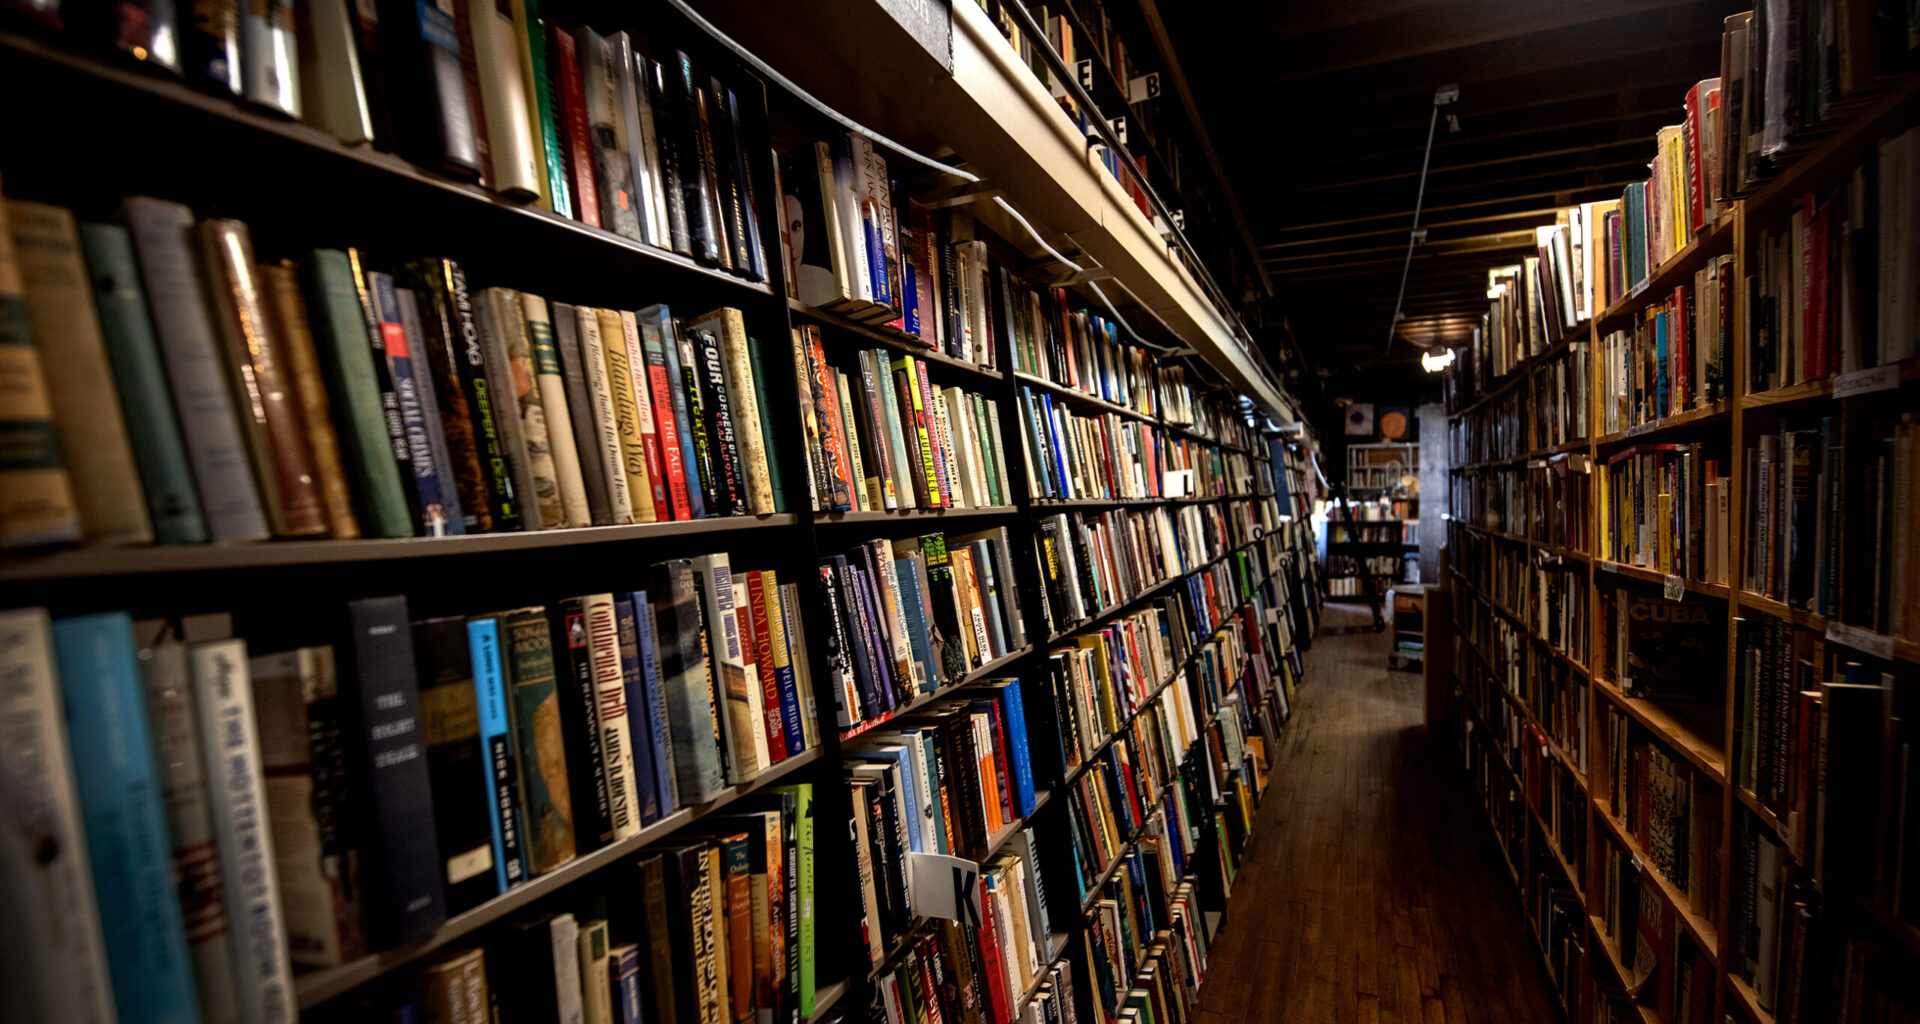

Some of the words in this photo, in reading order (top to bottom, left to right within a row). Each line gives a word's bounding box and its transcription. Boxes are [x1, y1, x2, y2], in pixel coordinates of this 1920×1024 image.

[1078, 61, 1090, 91] E
[1146, 76, 1159, 96] B
[1114, 117, 1125, 142] F
[1686, 110, 1701, 210] IMPERIAL
[874, 159, 890, 202] JOHN
[880, 202, 894, 241] JAKES
[451, 267, 471, 312] TAMI
[460, 309, 483, 367] HOAG
[623, 320, 639, 366] graphic
[588, 341, 607, 391] Blandings
[633, 367, 643, 385] the
[397, 376, 424, 426] SOCIAL
[472, 376, 497, 440] DEEPER
[598, 391, 613, 423] Builds
[635, 386, 650, 424] valley
[656, 388, 665, 409] TORO
[660, 368, 672, 412] GUILLERMO
[699, 328, 725, 387] FOUR
[714, 384, 735, 442] CORNERS
[730, 455, 743, 487] NIGHT
[901, 384, 916, 426] WAITING
[919, 370, 934, 415] JOHANSEN
[603, 423, 616, 441] His
[663, 419, 675, 443] THE
[408, 423, 437, 478] CRIMES
[606, 442, 622, 476] Dream
[624, 440, 648, 479] Way
[667, 445, 682, 476] FALL
[713, 411, 727, 450] CRAIG
[721, 453, 738, 503] HOLDEN
[919, 433, 938, 491] JOHANSEN
[489, 455, 509, 495] DEAD
[613, 476, 627, 506] House
[933, 449, 949, 496] JOHANSEN
[1184, 474, 1193, 496] L
[1244, 479, 1254, 493] N
[673, 481, 683, 509] HOGAN
[1253, 527, 1264, 540] O
[875, 546, 886, 577] STAIR
[748, 576, 767, 625] LINDA
[767, 575, 780, 612] LINDA
[914, 580, 919, 589] IN
[890, 582, 902, 617] Armstrong
[897, 617, 906, 639] Custer
[975, 613, 983, 633] FROM
[1277, 610, 1284, 622] P
[1630, 602, 1711, 624] CUBA
[588, 600, 622, 683] Continental
[698, 628, 709, 654] THE
[773, 611, 789, 665] HOWARD
[482, 645, 493, 673] LONG
[756, 630, 778, 700] HOWARD
[486, 675, 495, 696] WAY
[702, 655, 716, 702] NATION
[781, 667, 793, 690] VEIL
[785, 691, 793, 702] OF
[600, 684, 627, 721] Drift
[775, 707, 783, 728] OPEN
[787, 704, 800, 736] NIGHT
[709, 703, 722, 740] THIEF
[767, 708, 779, 738] SEASON
[492, 740, 508, 779] NICK
[604, 727, 621, 765] JAMES
[936, 756, 945, 780] KAVA
[498, 784, 517, 849] HORNBY
[610, 777, 629, 829] HOUSTON
[939, 786, 954, 841] EXPOSED
[768, 823, 775, 831] A
[893, 819, 902, 846] JUST
[697, 850, 709, 870] IN
[769, 836, 778, 863] Place
[698, 872, 712, 912] THE
[770, 867, 779, 900] Called
[953, 867, 982, 928] K
[689, 888, 704, 956] William
[771, 904, 782, 981] Armageddon
